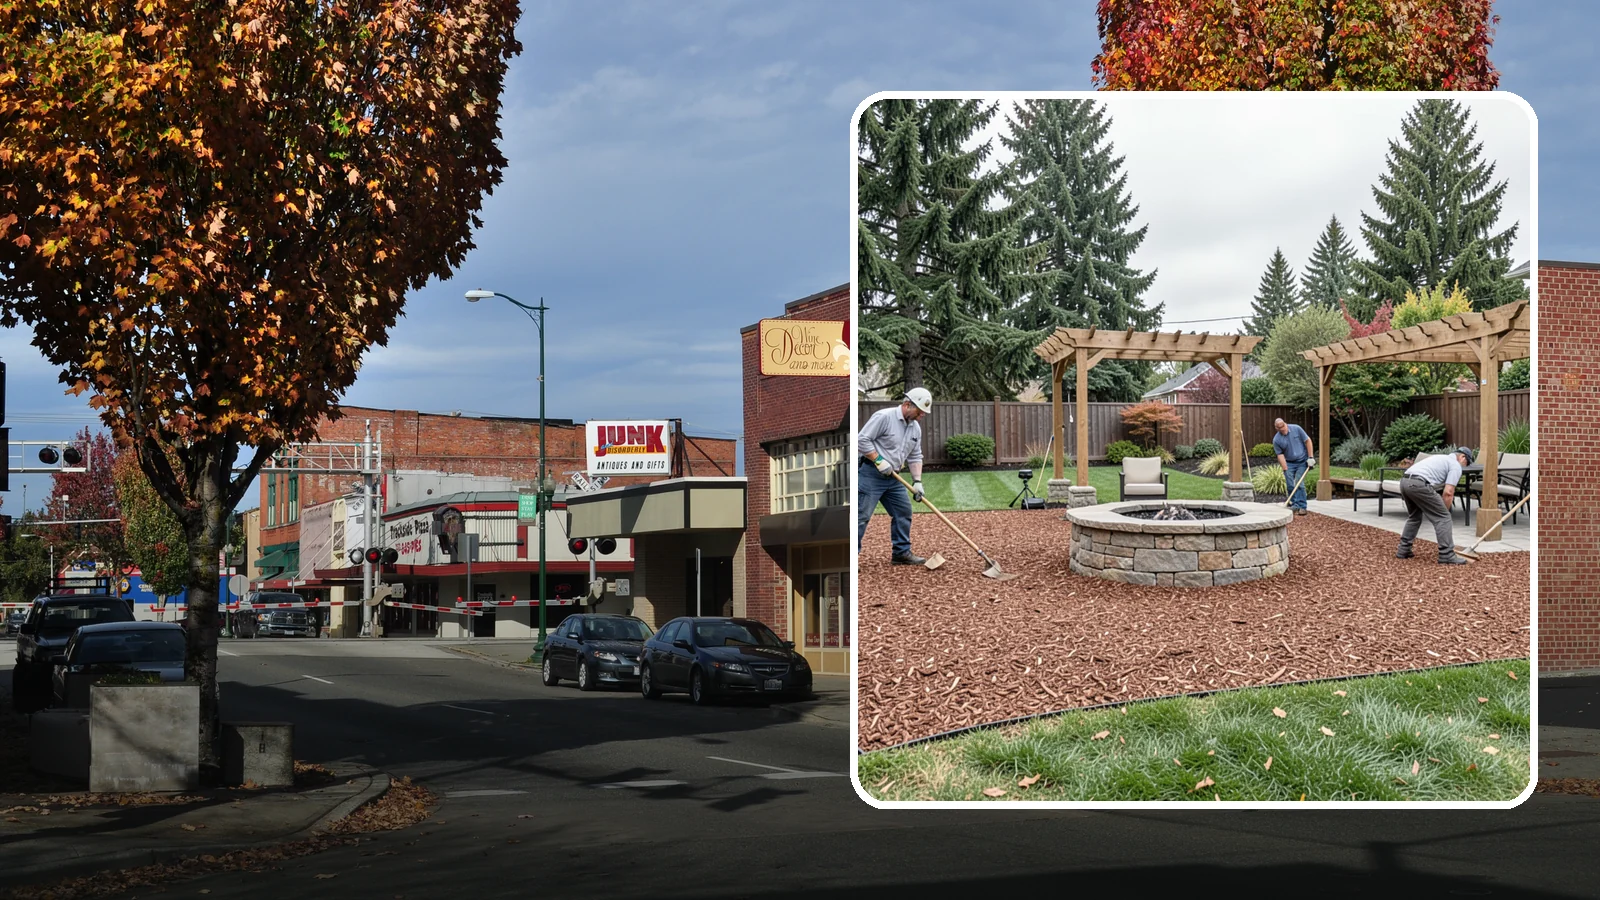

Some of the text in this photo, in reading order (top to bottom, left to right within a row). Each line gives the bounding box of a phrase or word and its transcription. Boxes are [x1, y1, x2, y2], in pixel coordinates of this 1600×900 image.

[596, 426, 665, 456] JUNK
[607, 446, 646, 454] DISORDERLY
[597, 460, 666, 470] ANTIQUES AND GIFTS
[573, 473, 589, 493] RAIL
[590, 476, 608, 492] SING
[352, 498, 365, 511] CRO
[390, 519, 429, 540] Trackside Pizza
